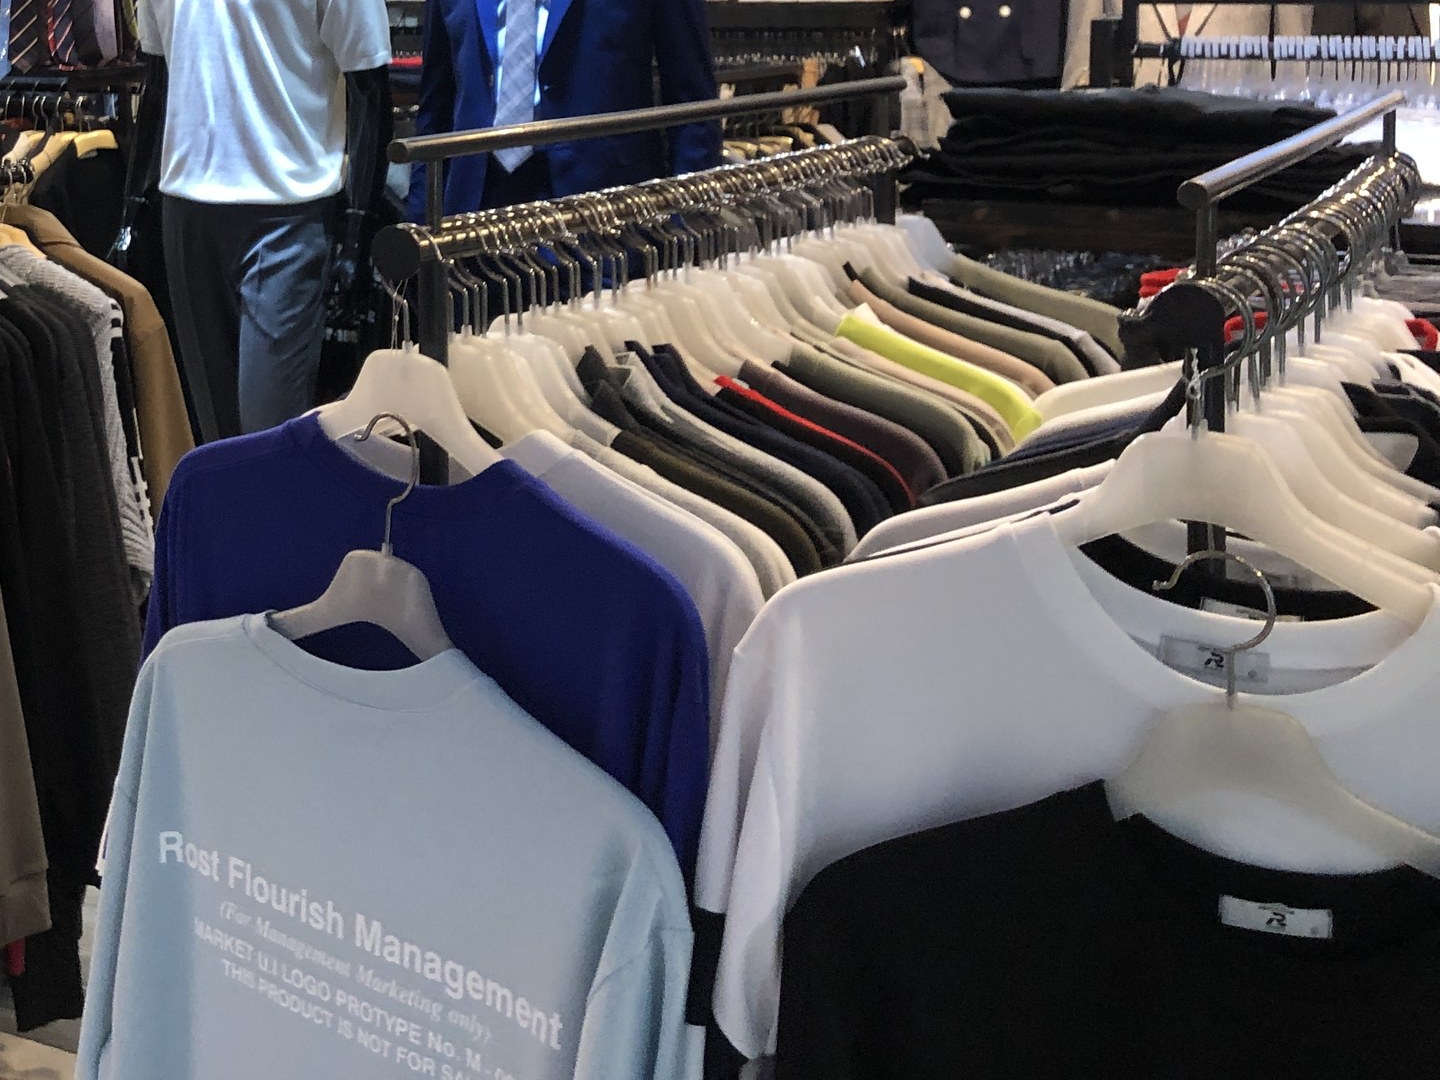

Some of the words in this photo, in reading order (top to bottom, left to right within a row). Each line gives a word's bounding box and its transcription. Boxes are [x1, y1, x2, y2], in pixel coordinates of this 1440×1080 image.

[228, 855, 346, 940] Flourish
[355, 912, 564, 1051] Management
[282, 964, 332, 1002] LOGO
[335, 988, 423, 1046] PROTYPE
[220, 958, 257, 989] THIS
[258, 977, 333, 1029] PRODUCT
[336, 1017, 353, 1040] IS
[356, 1026, 392, 1059] NOT
[396, 1046, 436, 1078] FOR
